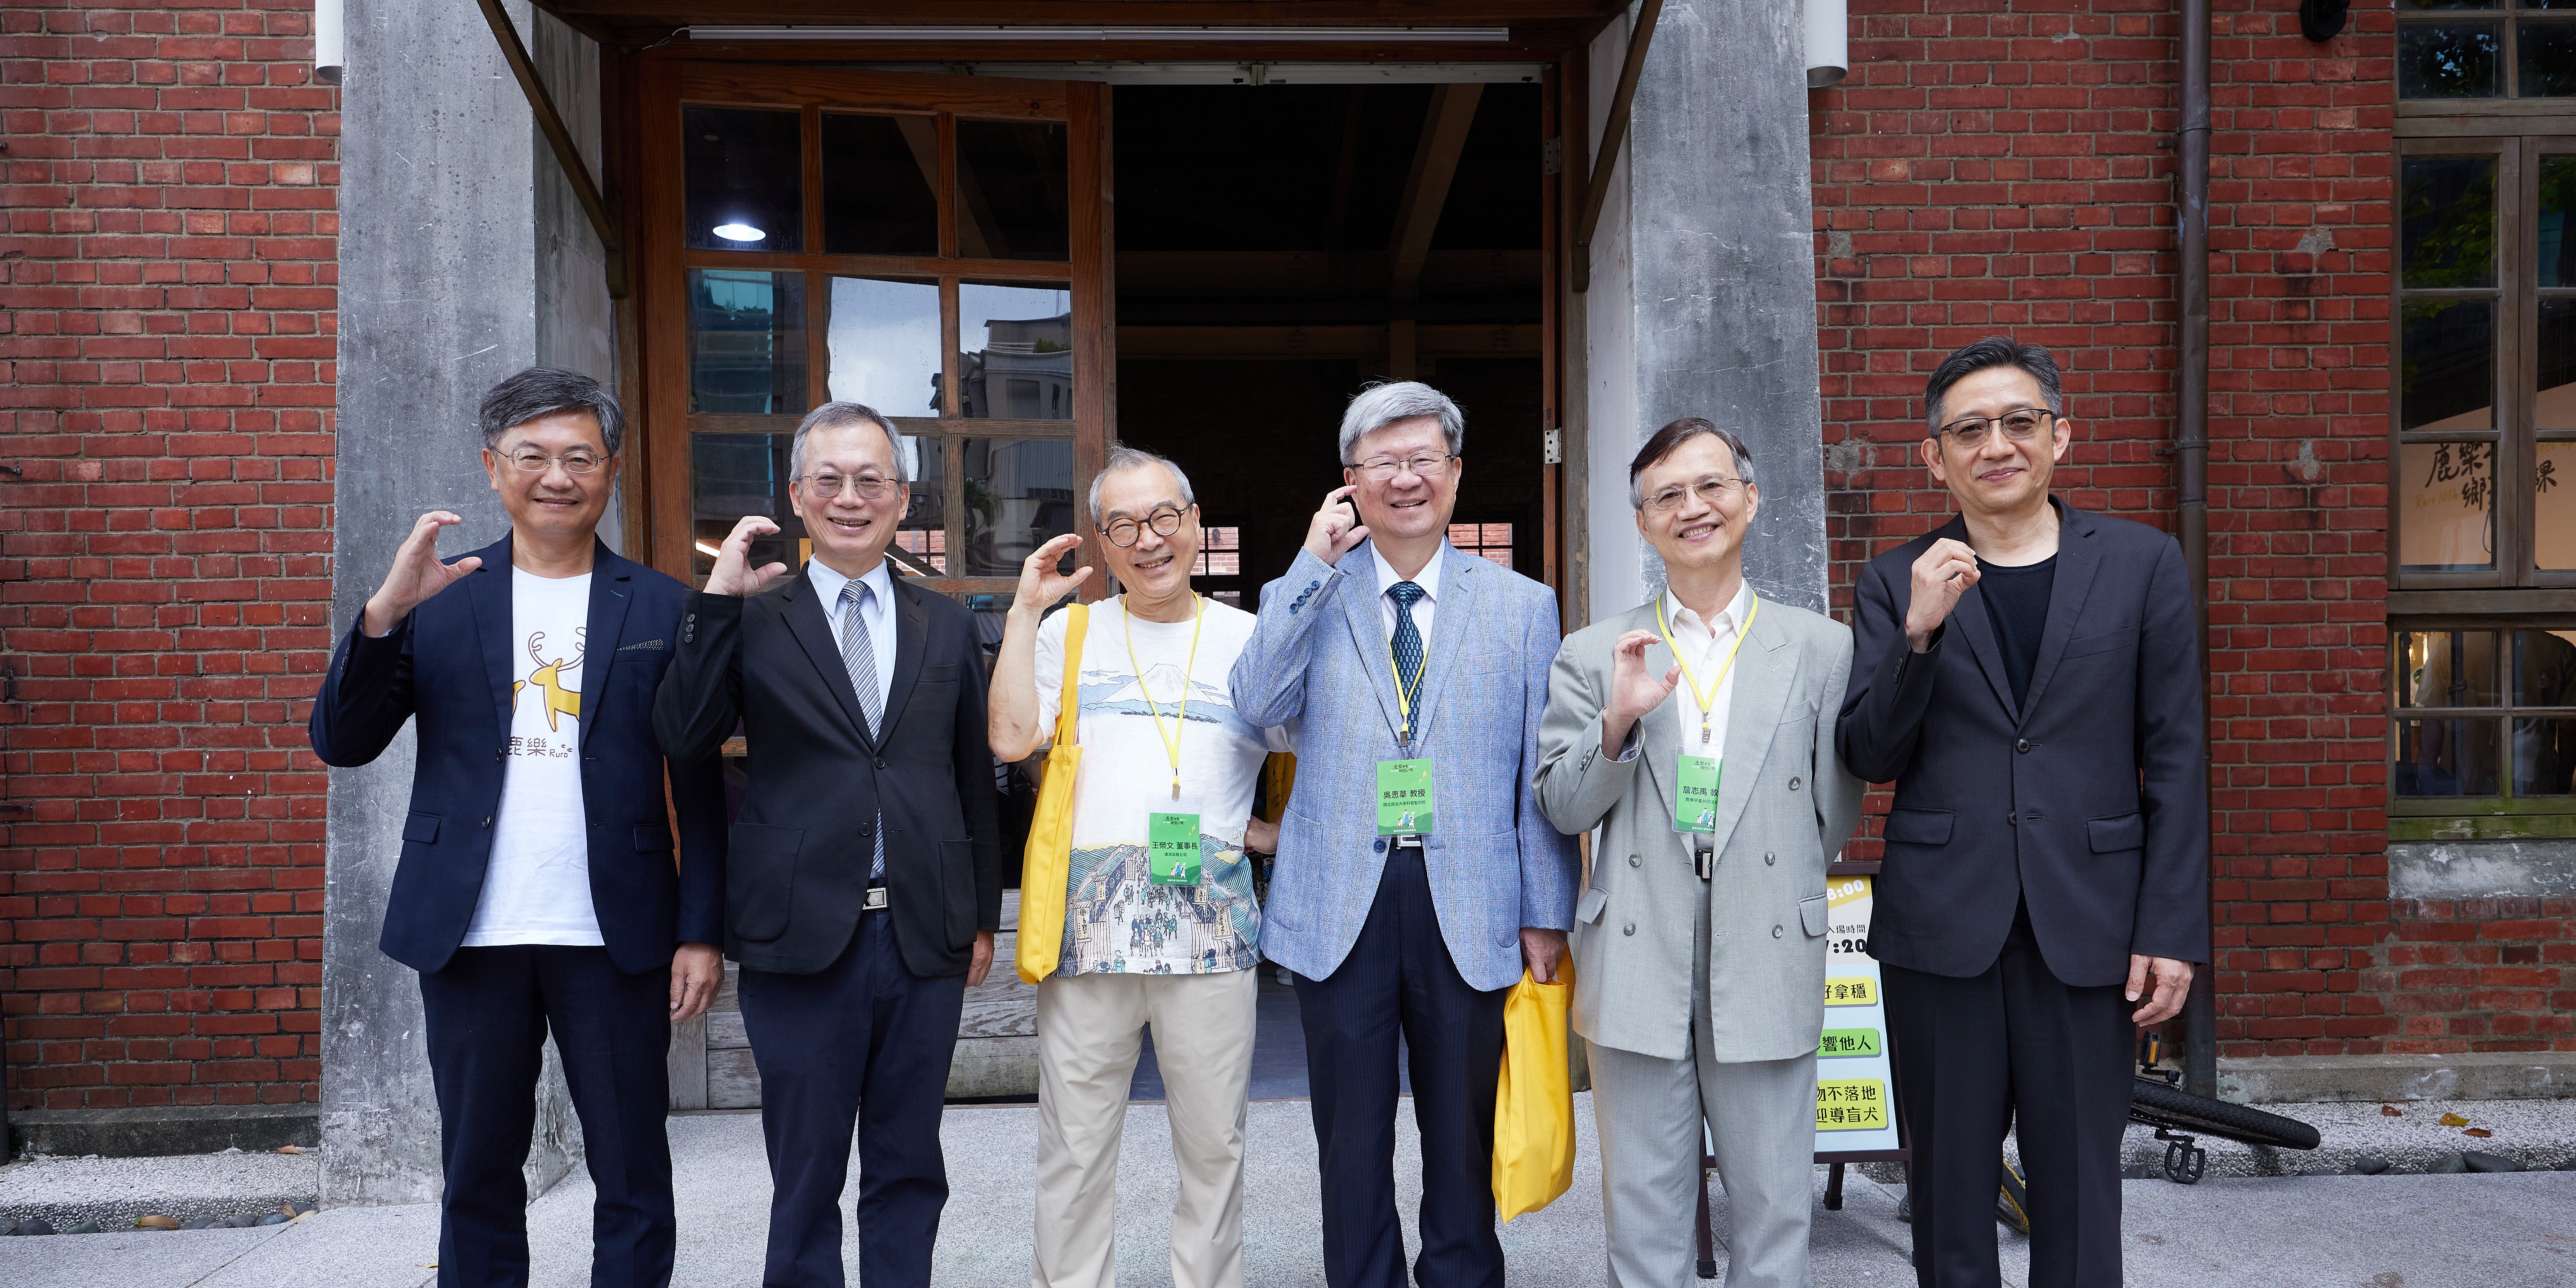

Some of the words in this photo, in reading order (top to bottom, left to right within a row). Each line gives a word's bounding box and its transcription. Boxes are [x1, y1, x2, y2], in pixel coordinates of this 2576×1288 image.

[549, 749, 568, 757] Ruro
[1383, 790, 1407, 799] 吳思華
[1410, 789, 1425, 797] 教授
[1683, 785, 1707, 796] 詹志禹
[1176, 842, 1198, 850] 董事長
[1827, 925, 1865, 934] 入場時間
[1827, 938, 1866, 953] :20
[1817, 1035, 1872, 1052] 響他人
